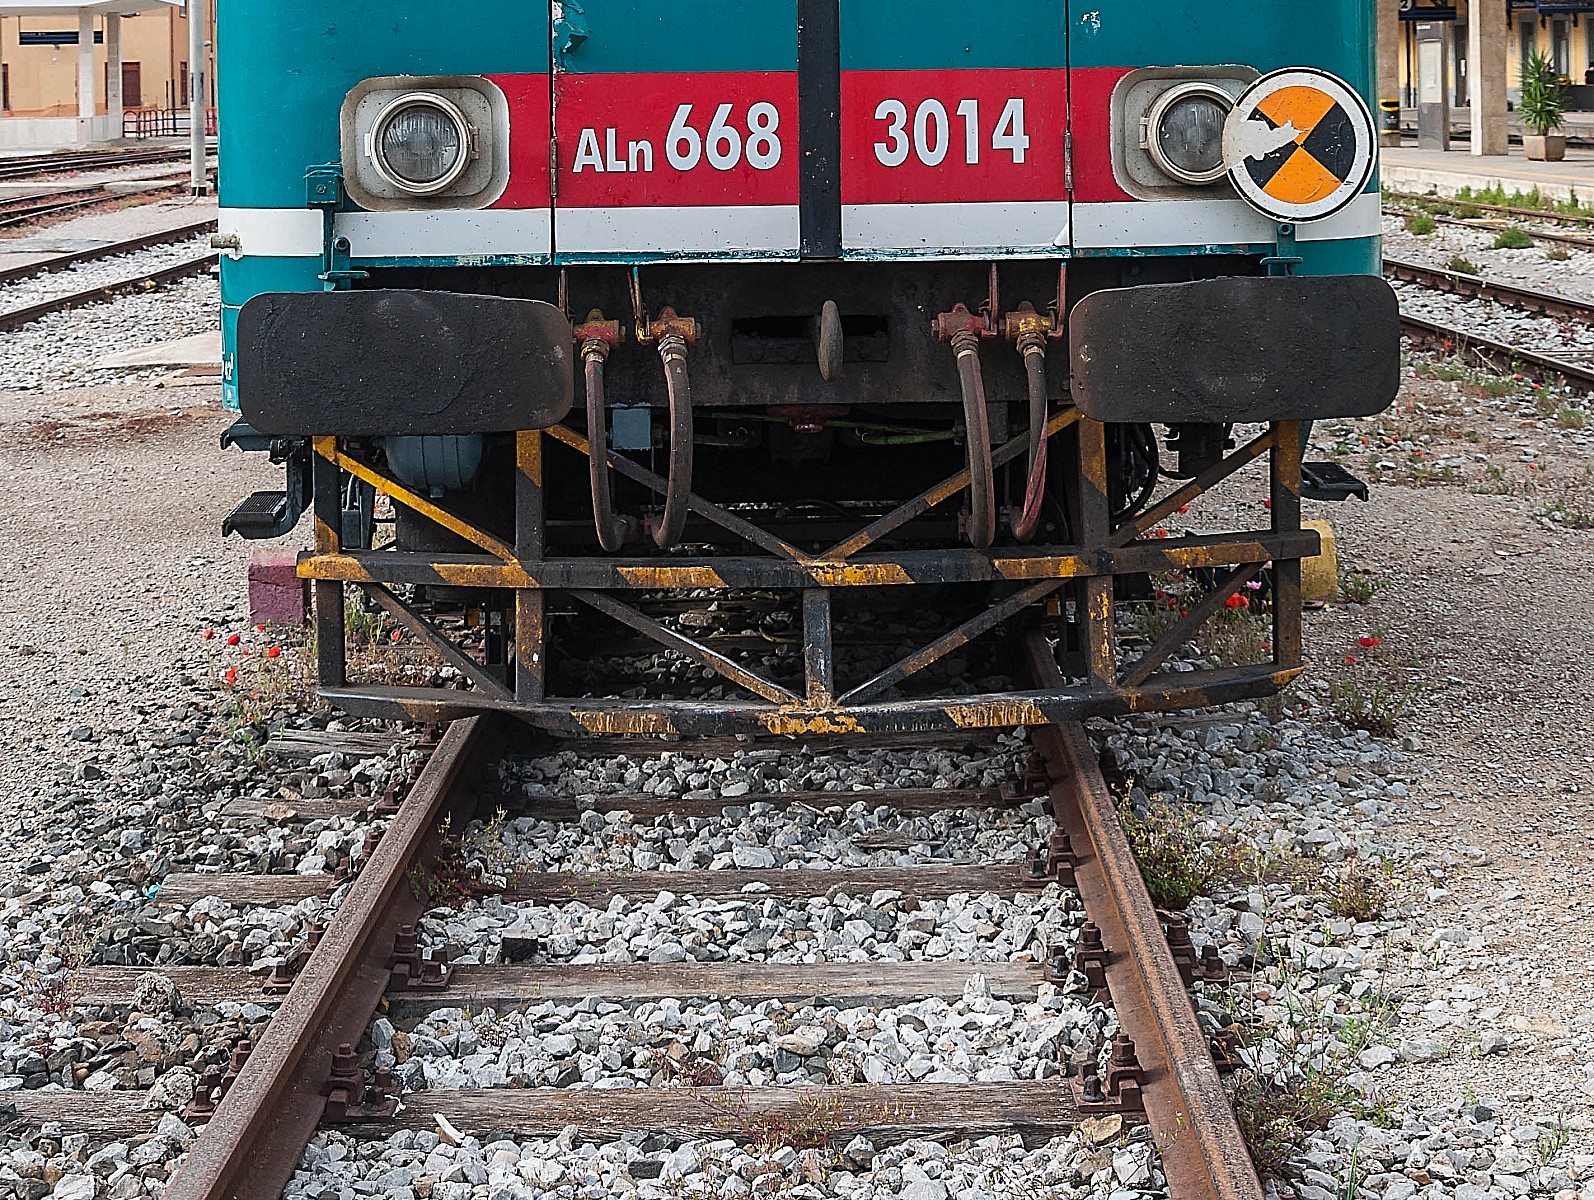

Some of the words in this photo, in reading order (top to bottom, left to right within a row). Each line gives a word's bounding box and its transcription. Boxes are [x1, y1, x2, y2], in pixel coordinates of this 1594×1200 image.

[572, 128, 654, 173] ALn
[665, 101, 782, 171] 668
[873, 98, 1031, 167] 3014
